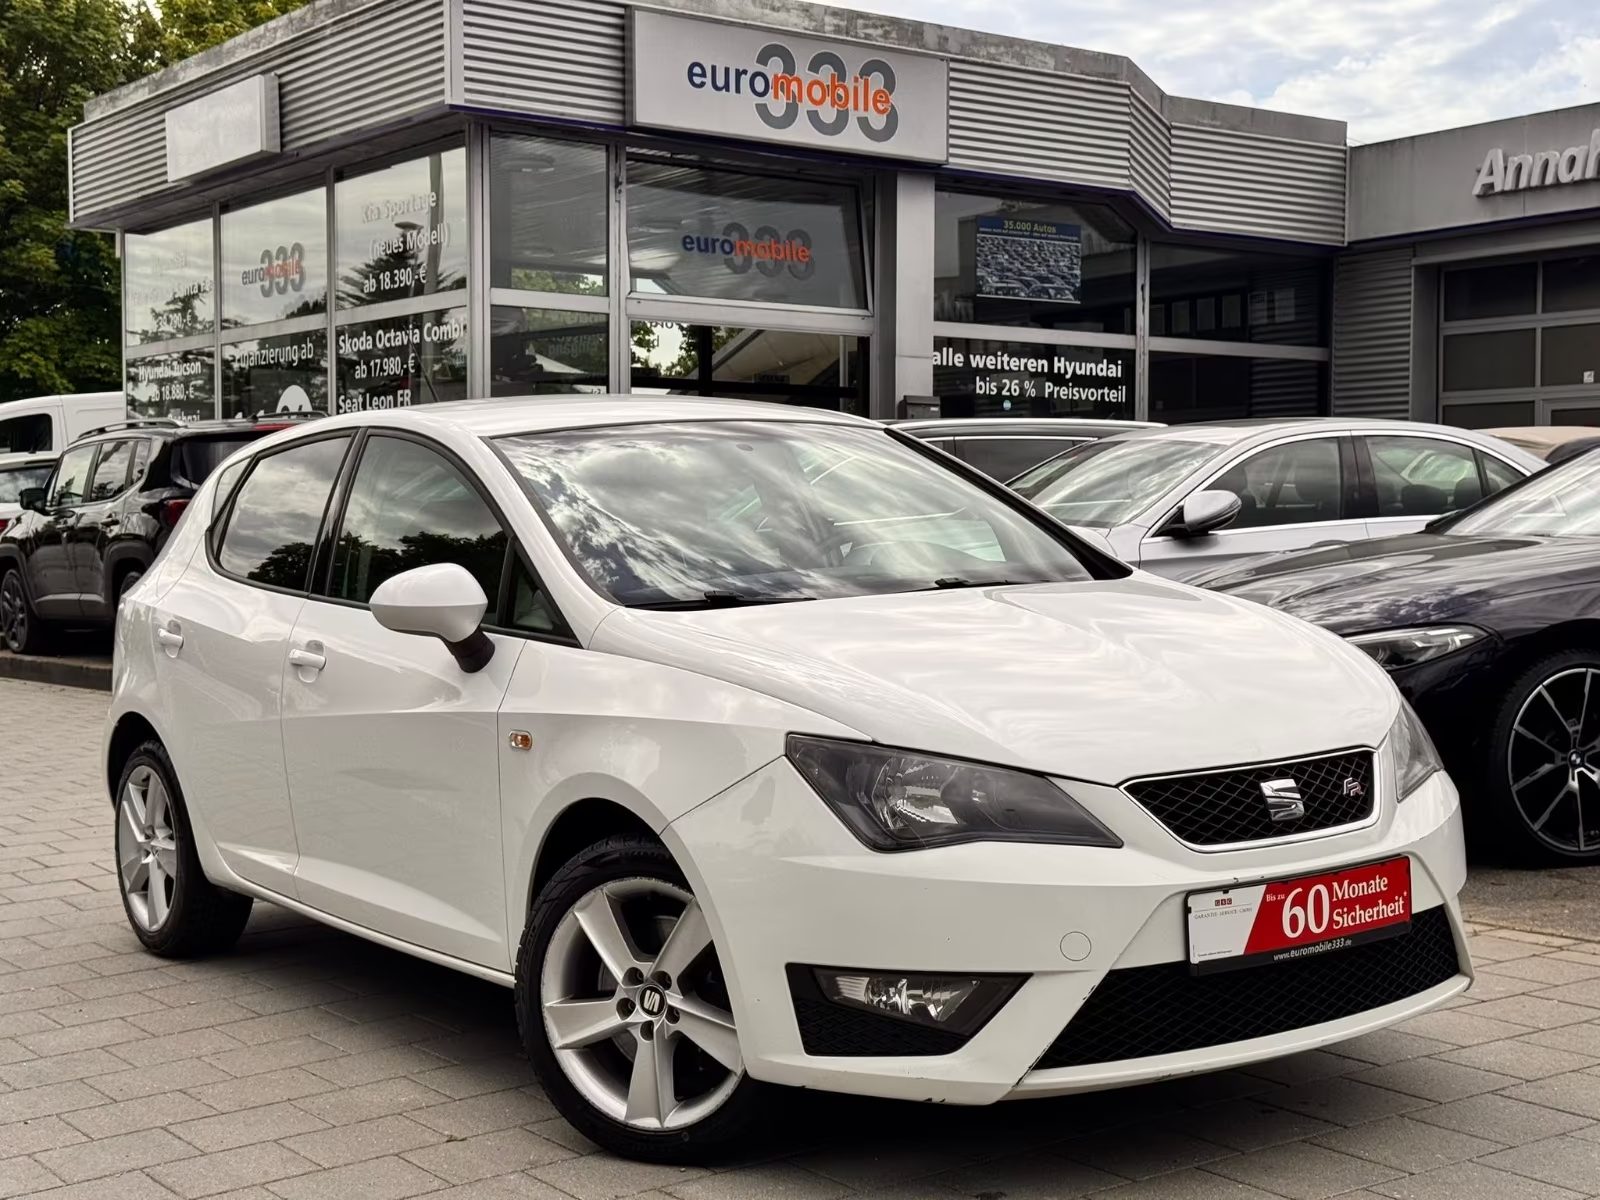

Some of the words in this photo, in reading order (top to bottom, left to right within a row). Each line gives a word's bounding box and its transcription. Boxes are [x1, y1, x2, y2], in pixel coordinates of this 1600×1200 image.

[687, 61, 891, 116] euromobile
[754, 42, 898, 142] 333
[1003, 220, 1032, 231] 35.000
[1033, 224, 1057, 233] Autos
[682, 234, 811, 263] euromobile
[721, 223, 815, 281] 333
[363, 274, 376, 293] ab
[301, 337, 314, 360] ab
[339, 330, 372, 354] Skoda
[375, 324, 420, 348] Octavia
[354, 359, 367, 379] ab
[932, 347, 964, 367] alle
[970, 351, 1048, 373] weiteren
[1053, 356, 1122, 379] Hyundai
[338, 393, 363, 414] Seat
[366, 392, 394, 411] Leon
[975, 376, 997, 396] bis
[1001, 378, 1020, 396] 26
[1024, 379, 1036, 397] %
[1044, 381, 1126, 403] Preisvorteil
[1332, 874, 1388, 902] Monate
[1266, 894, 1276, 902] Bis
[1281, 883, 1330, 939] 60
[1273, 938, 1352, 961] www.euromobile333.de
